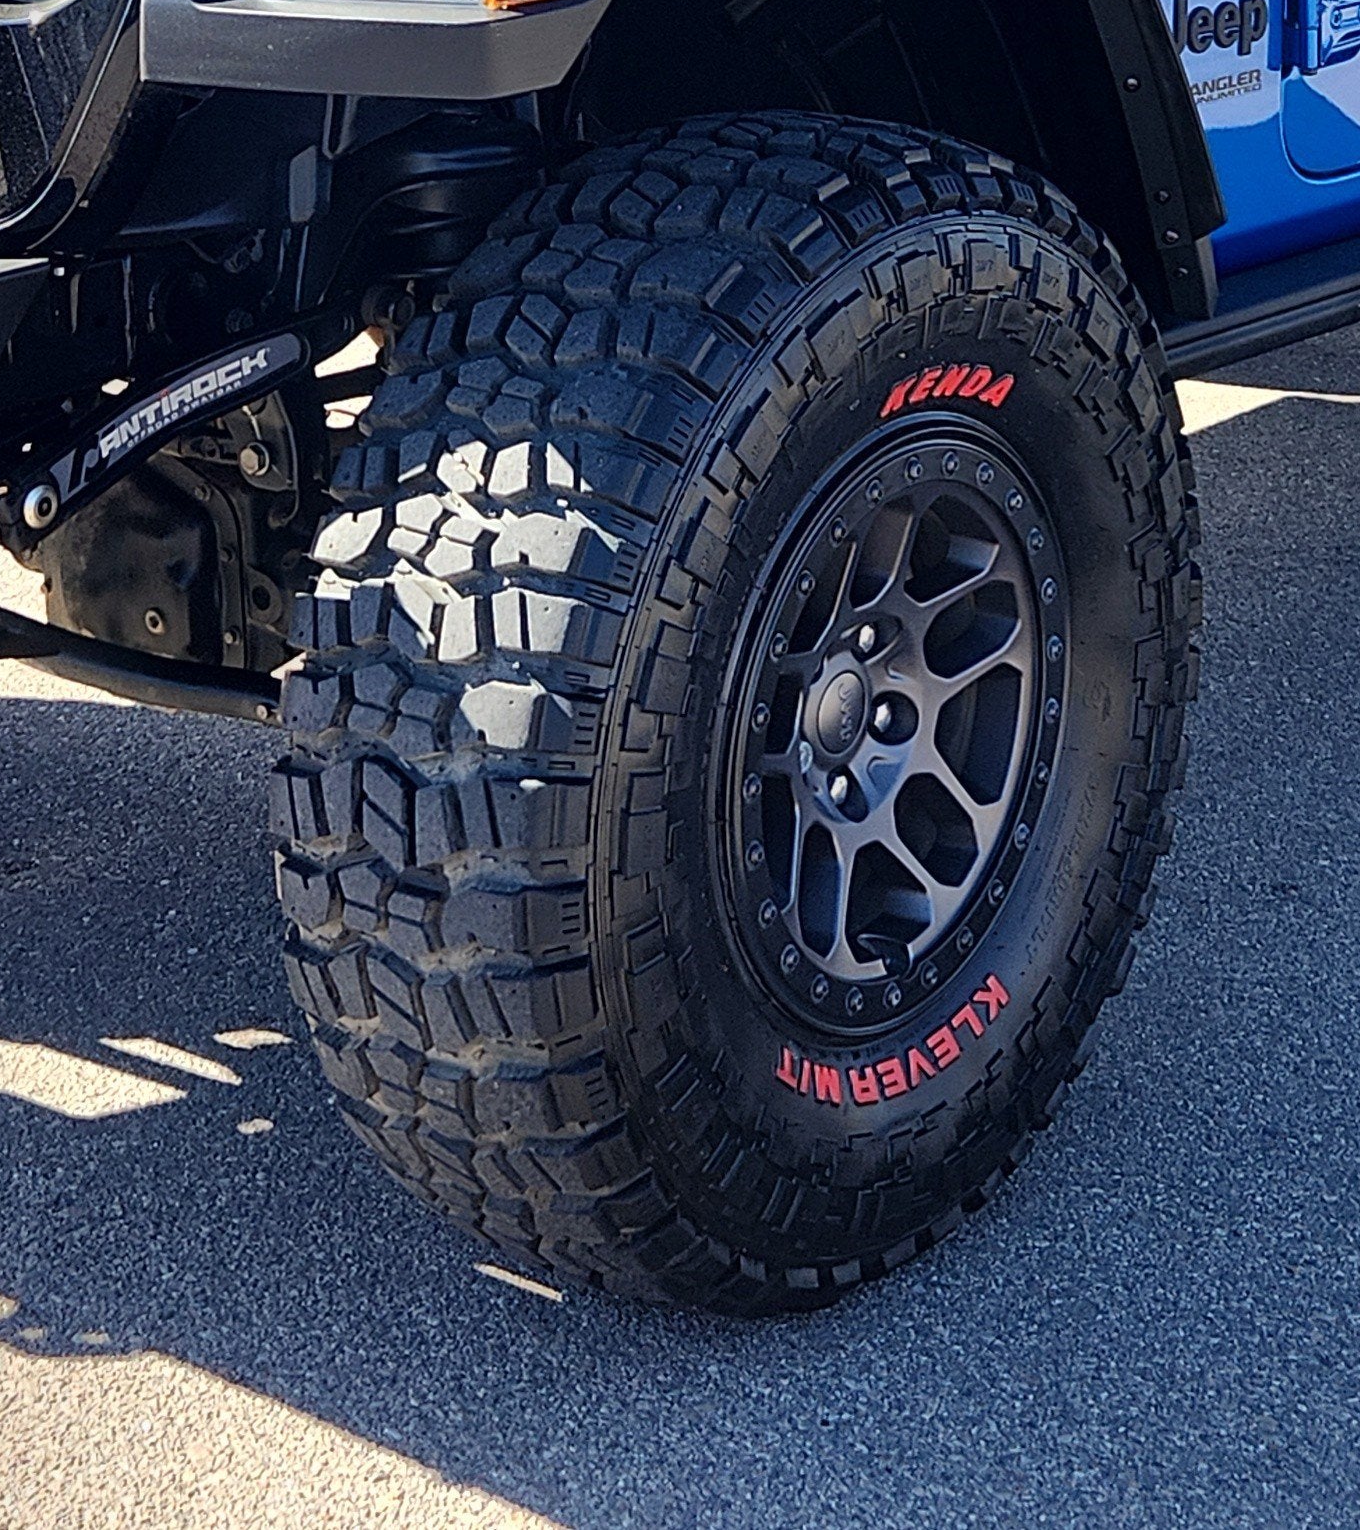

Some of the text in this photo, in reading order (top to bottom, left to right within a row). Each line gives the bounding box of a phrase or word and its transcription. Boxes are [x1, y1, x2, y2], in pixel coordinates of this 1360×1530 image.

[1190, 68, 1262, 97] ANGLER
[99, 348, 268, 459] ANTIROCK
[880, 363, 1016, 419] KENDA
[849, 973, 1011, 1106] KLEVER
